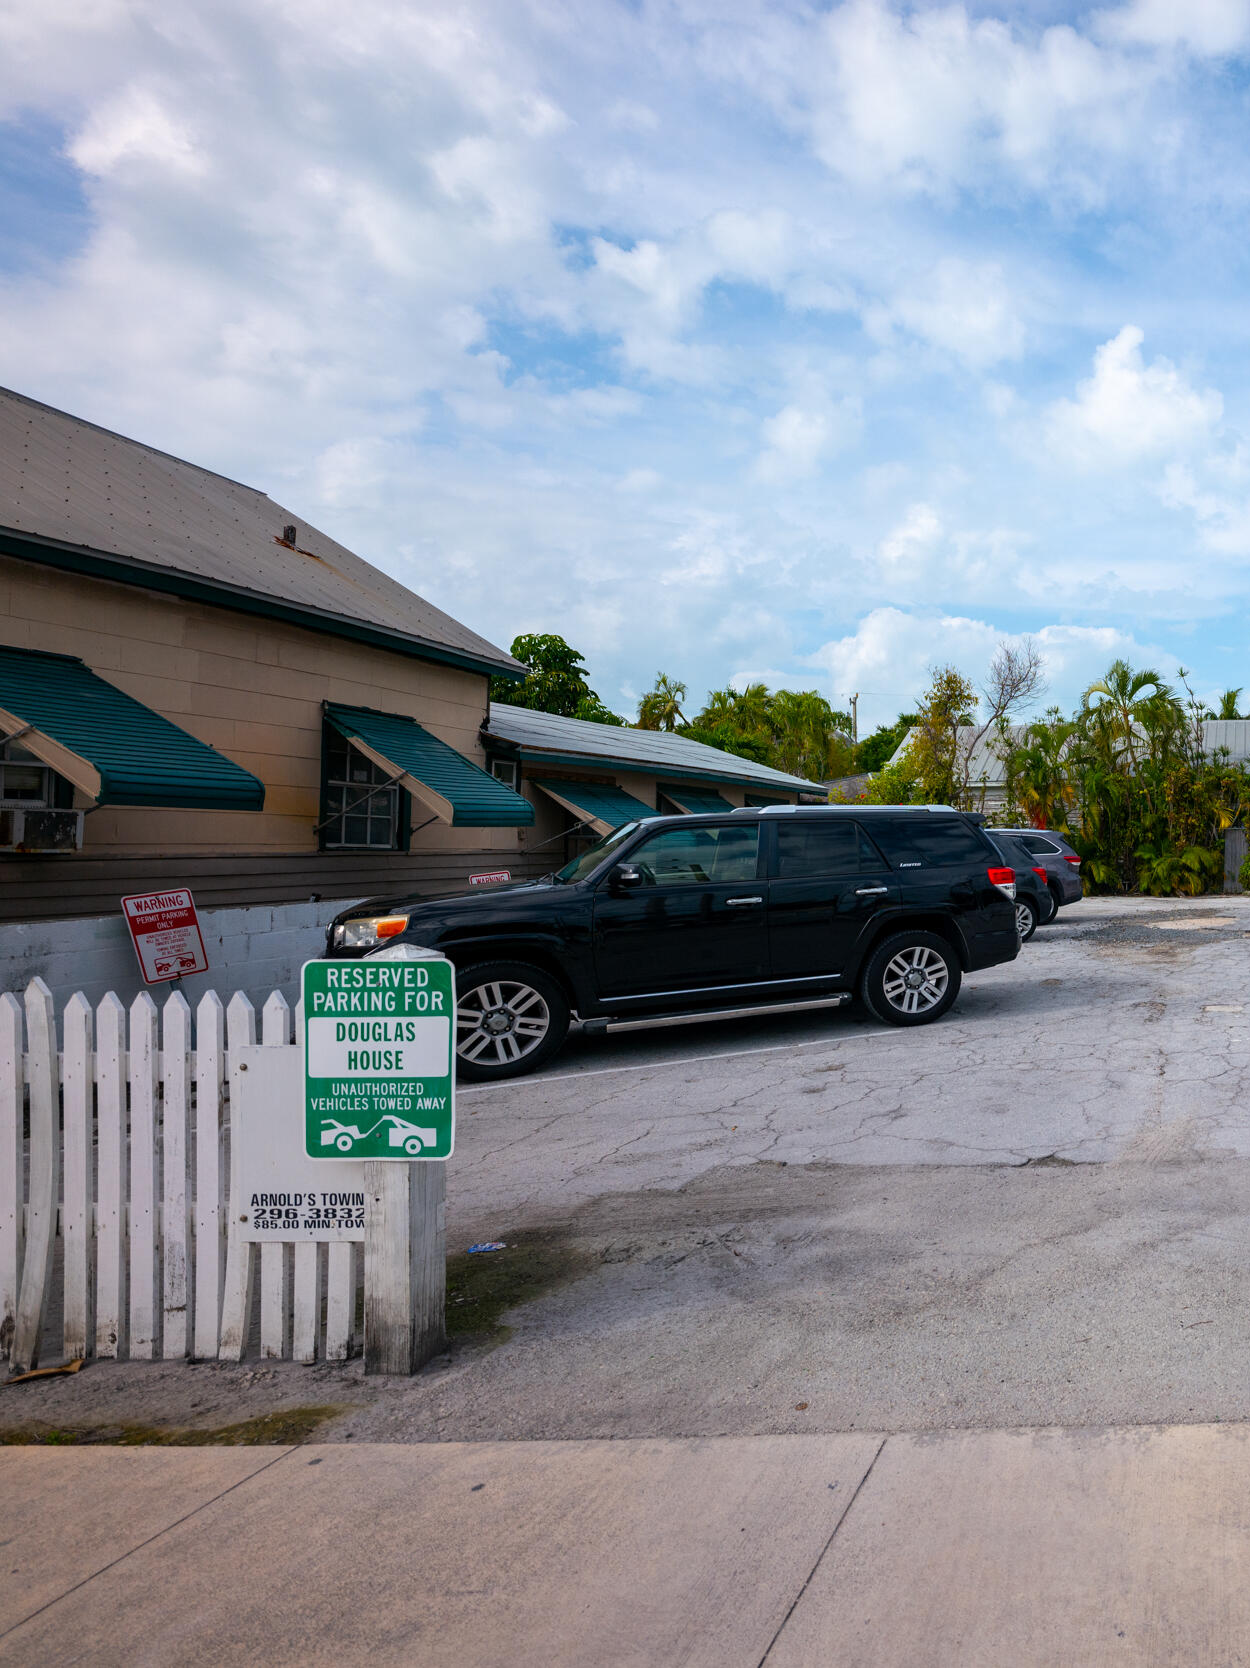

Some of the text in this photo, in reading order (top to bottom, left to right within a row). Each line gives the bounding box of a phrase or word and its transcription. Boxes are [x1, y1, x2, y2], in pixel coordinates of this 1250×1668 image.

[133, 895, 184, 912] WARNING
[136, 910, 189, 925] PERMIT PARKING
[157, 921, 174, 930] ONLY
[327, 968, 429, 988] RESERVED
[313, 991, 444, 1012] PARKING FOR
[336, 1022, 416, 1042] DOUGLAS
[347, 1050, 404, 1070] HOUSE
[332, 1082, 424, 1096] UNAUTHORIZED
[311, 1097, 447, 1111] VEHICLES TOWED AWAY
[251, 1193, 365, 1207] ARNOLD'S TOWIN
[253, 1207, 365, 1220] 296-3832
[253, 1219, 299, 1230] $85.00
